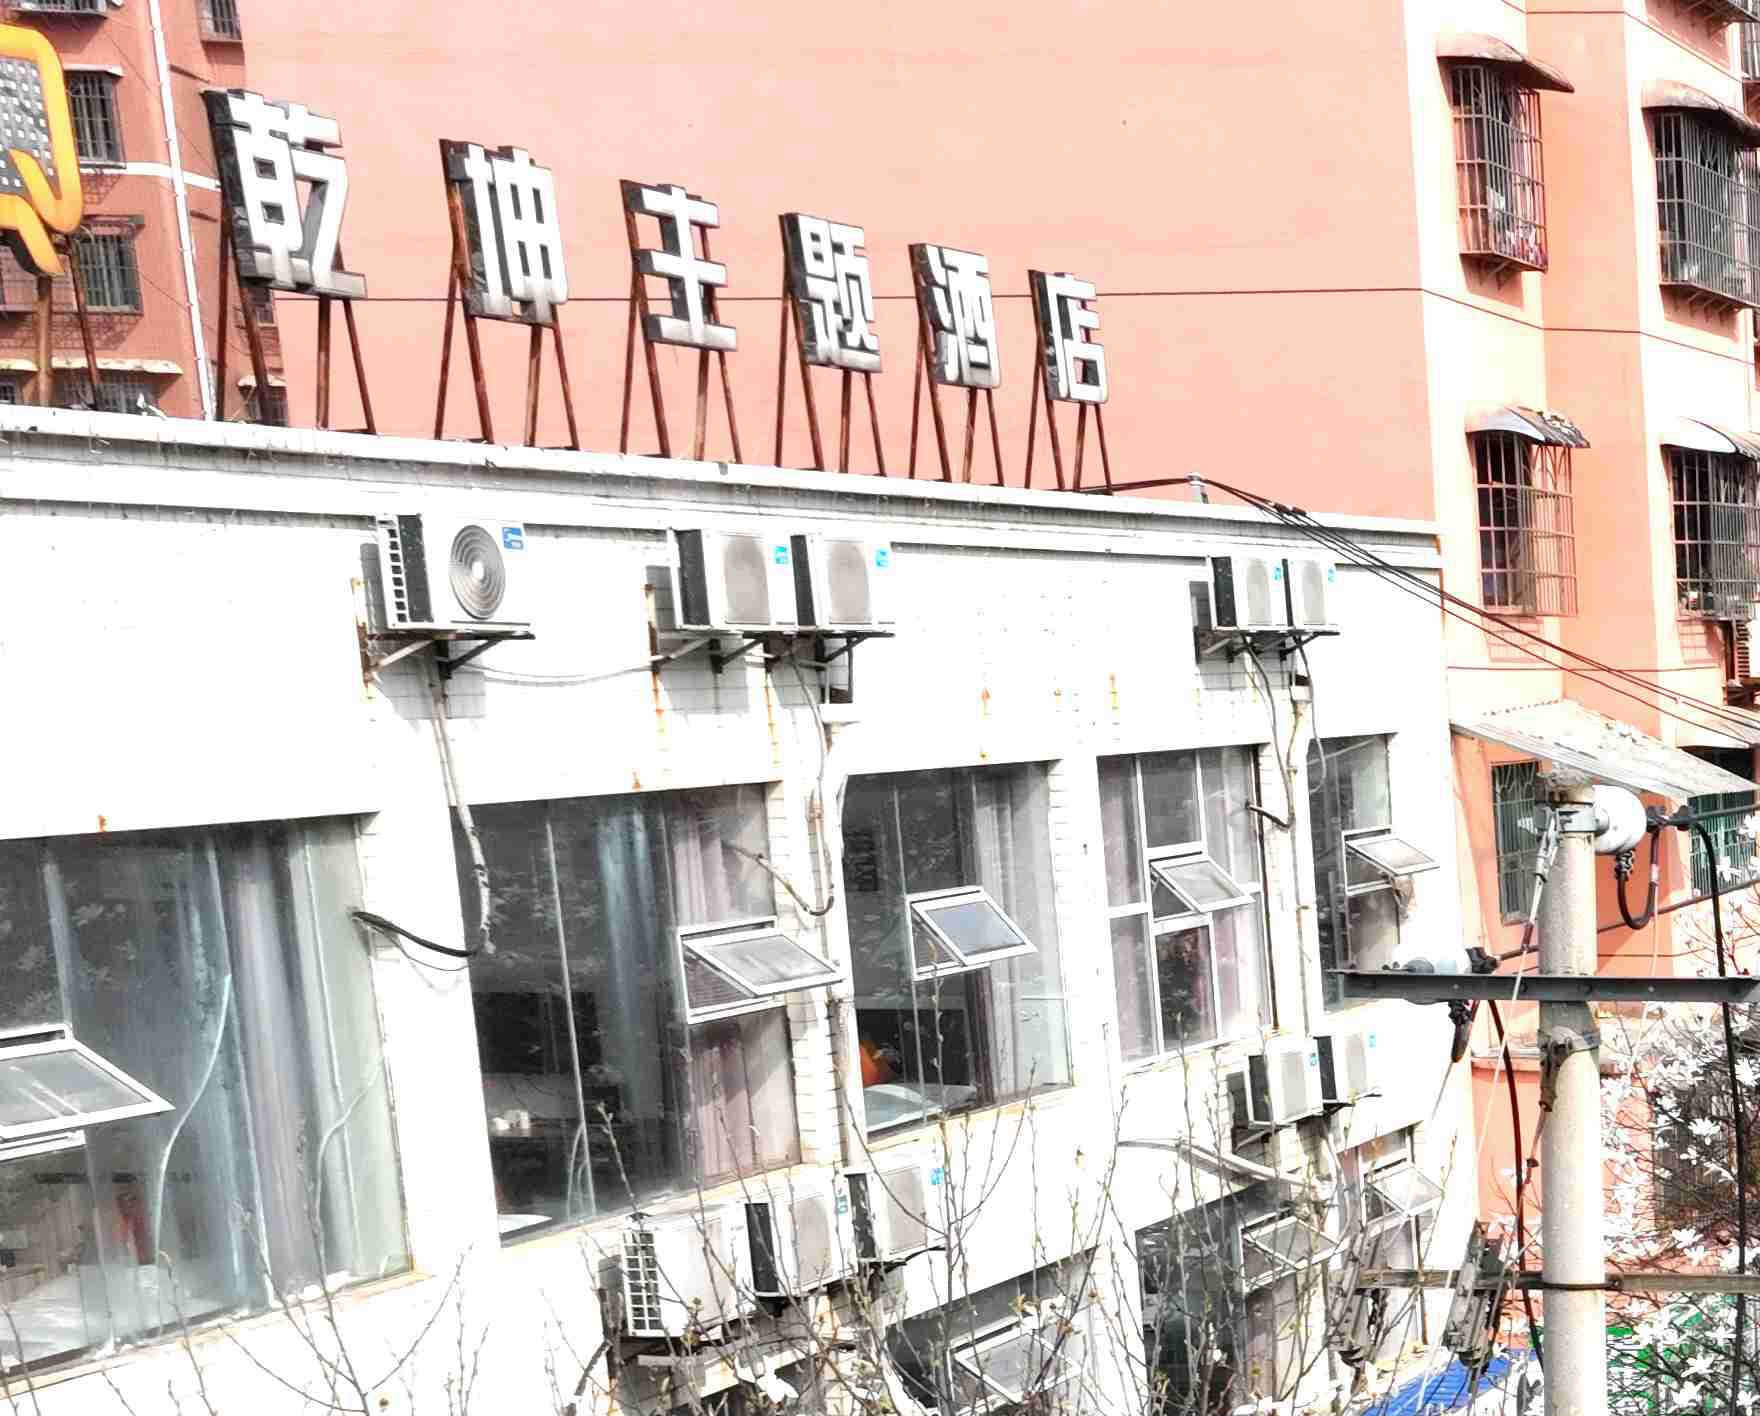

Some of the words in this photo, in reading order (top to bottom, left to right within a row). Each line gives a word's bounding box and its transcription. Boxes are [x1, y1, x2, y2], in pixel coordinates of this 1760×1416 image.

[208, 89, 1110, 405] 乾坤主题酒店
